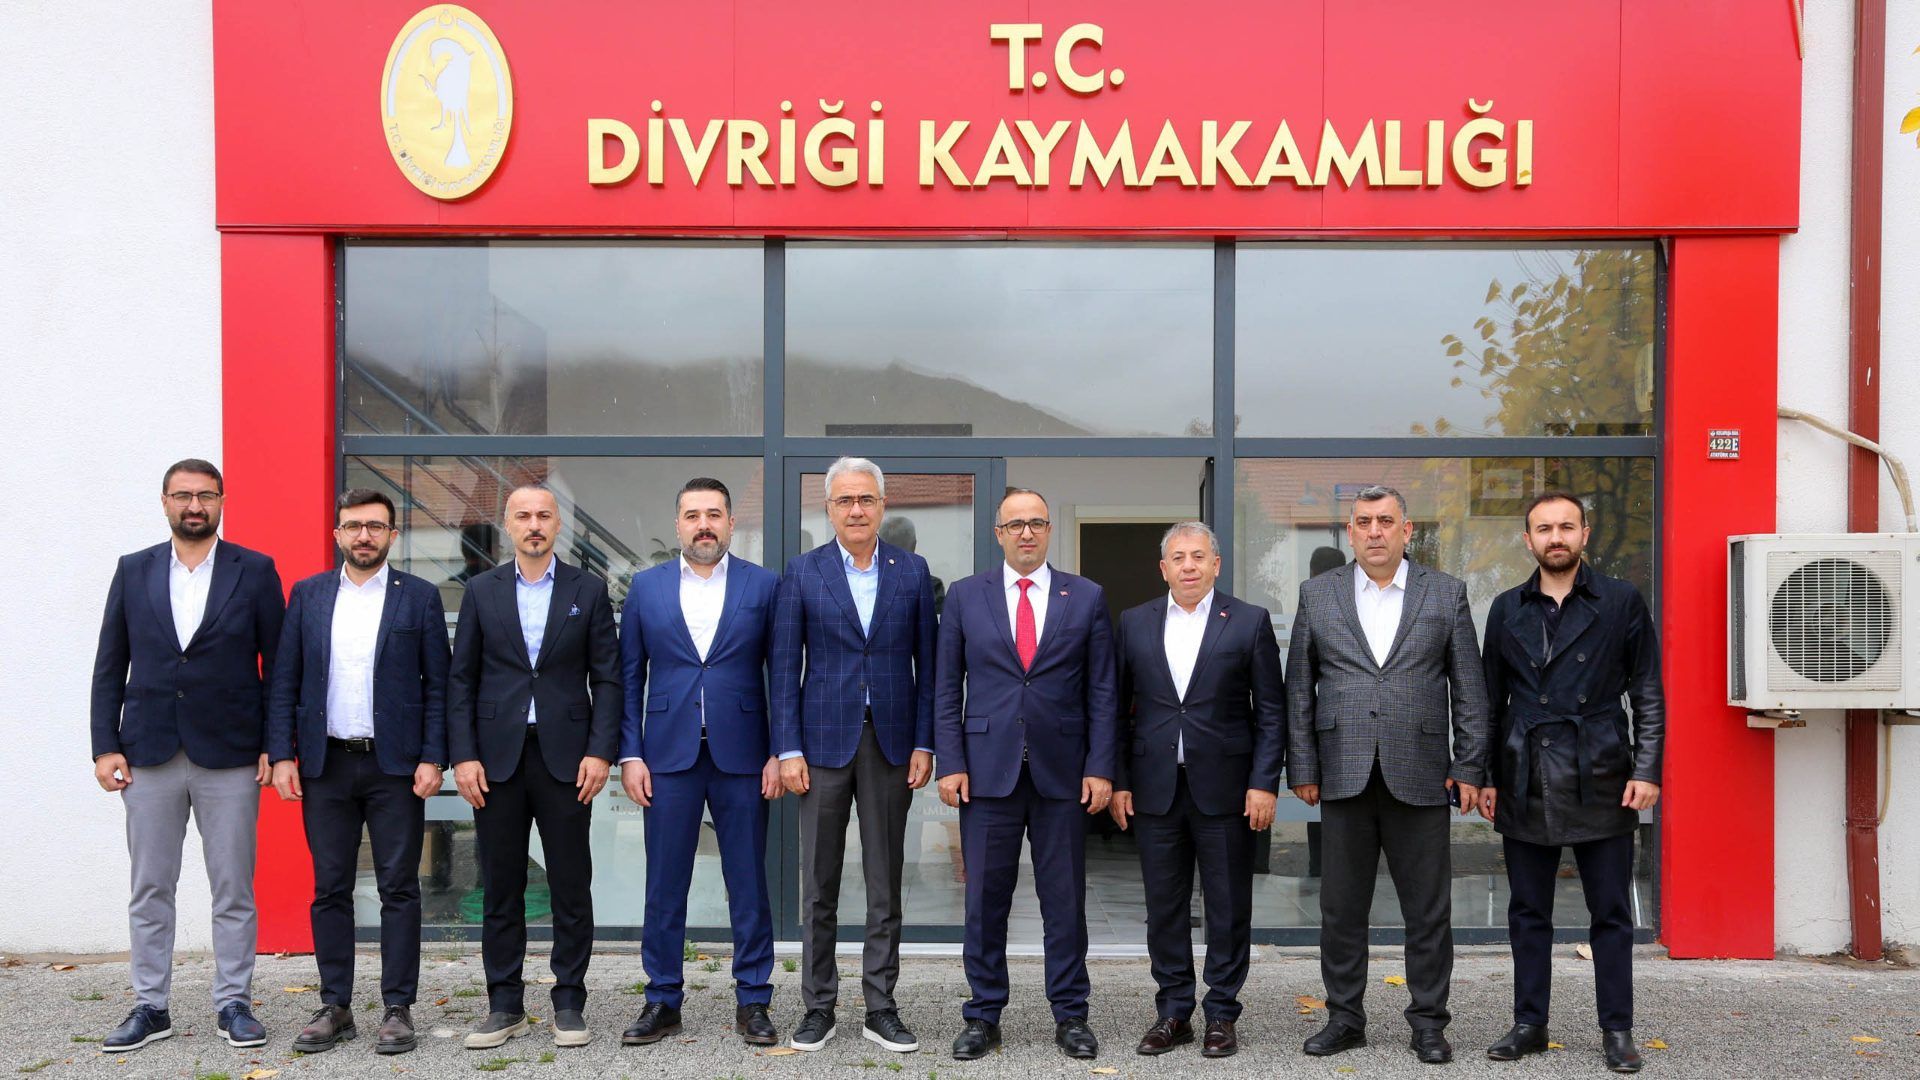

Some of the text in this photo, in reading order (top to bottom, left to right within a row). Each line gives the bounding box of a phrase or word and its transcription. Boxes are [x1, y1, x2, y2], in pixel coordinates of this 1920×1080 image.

[990, 23, 1125, 93] T.C.
[587, 97, 1534, 188] DİVRİĞİ KAYMAKAMLIĞI
